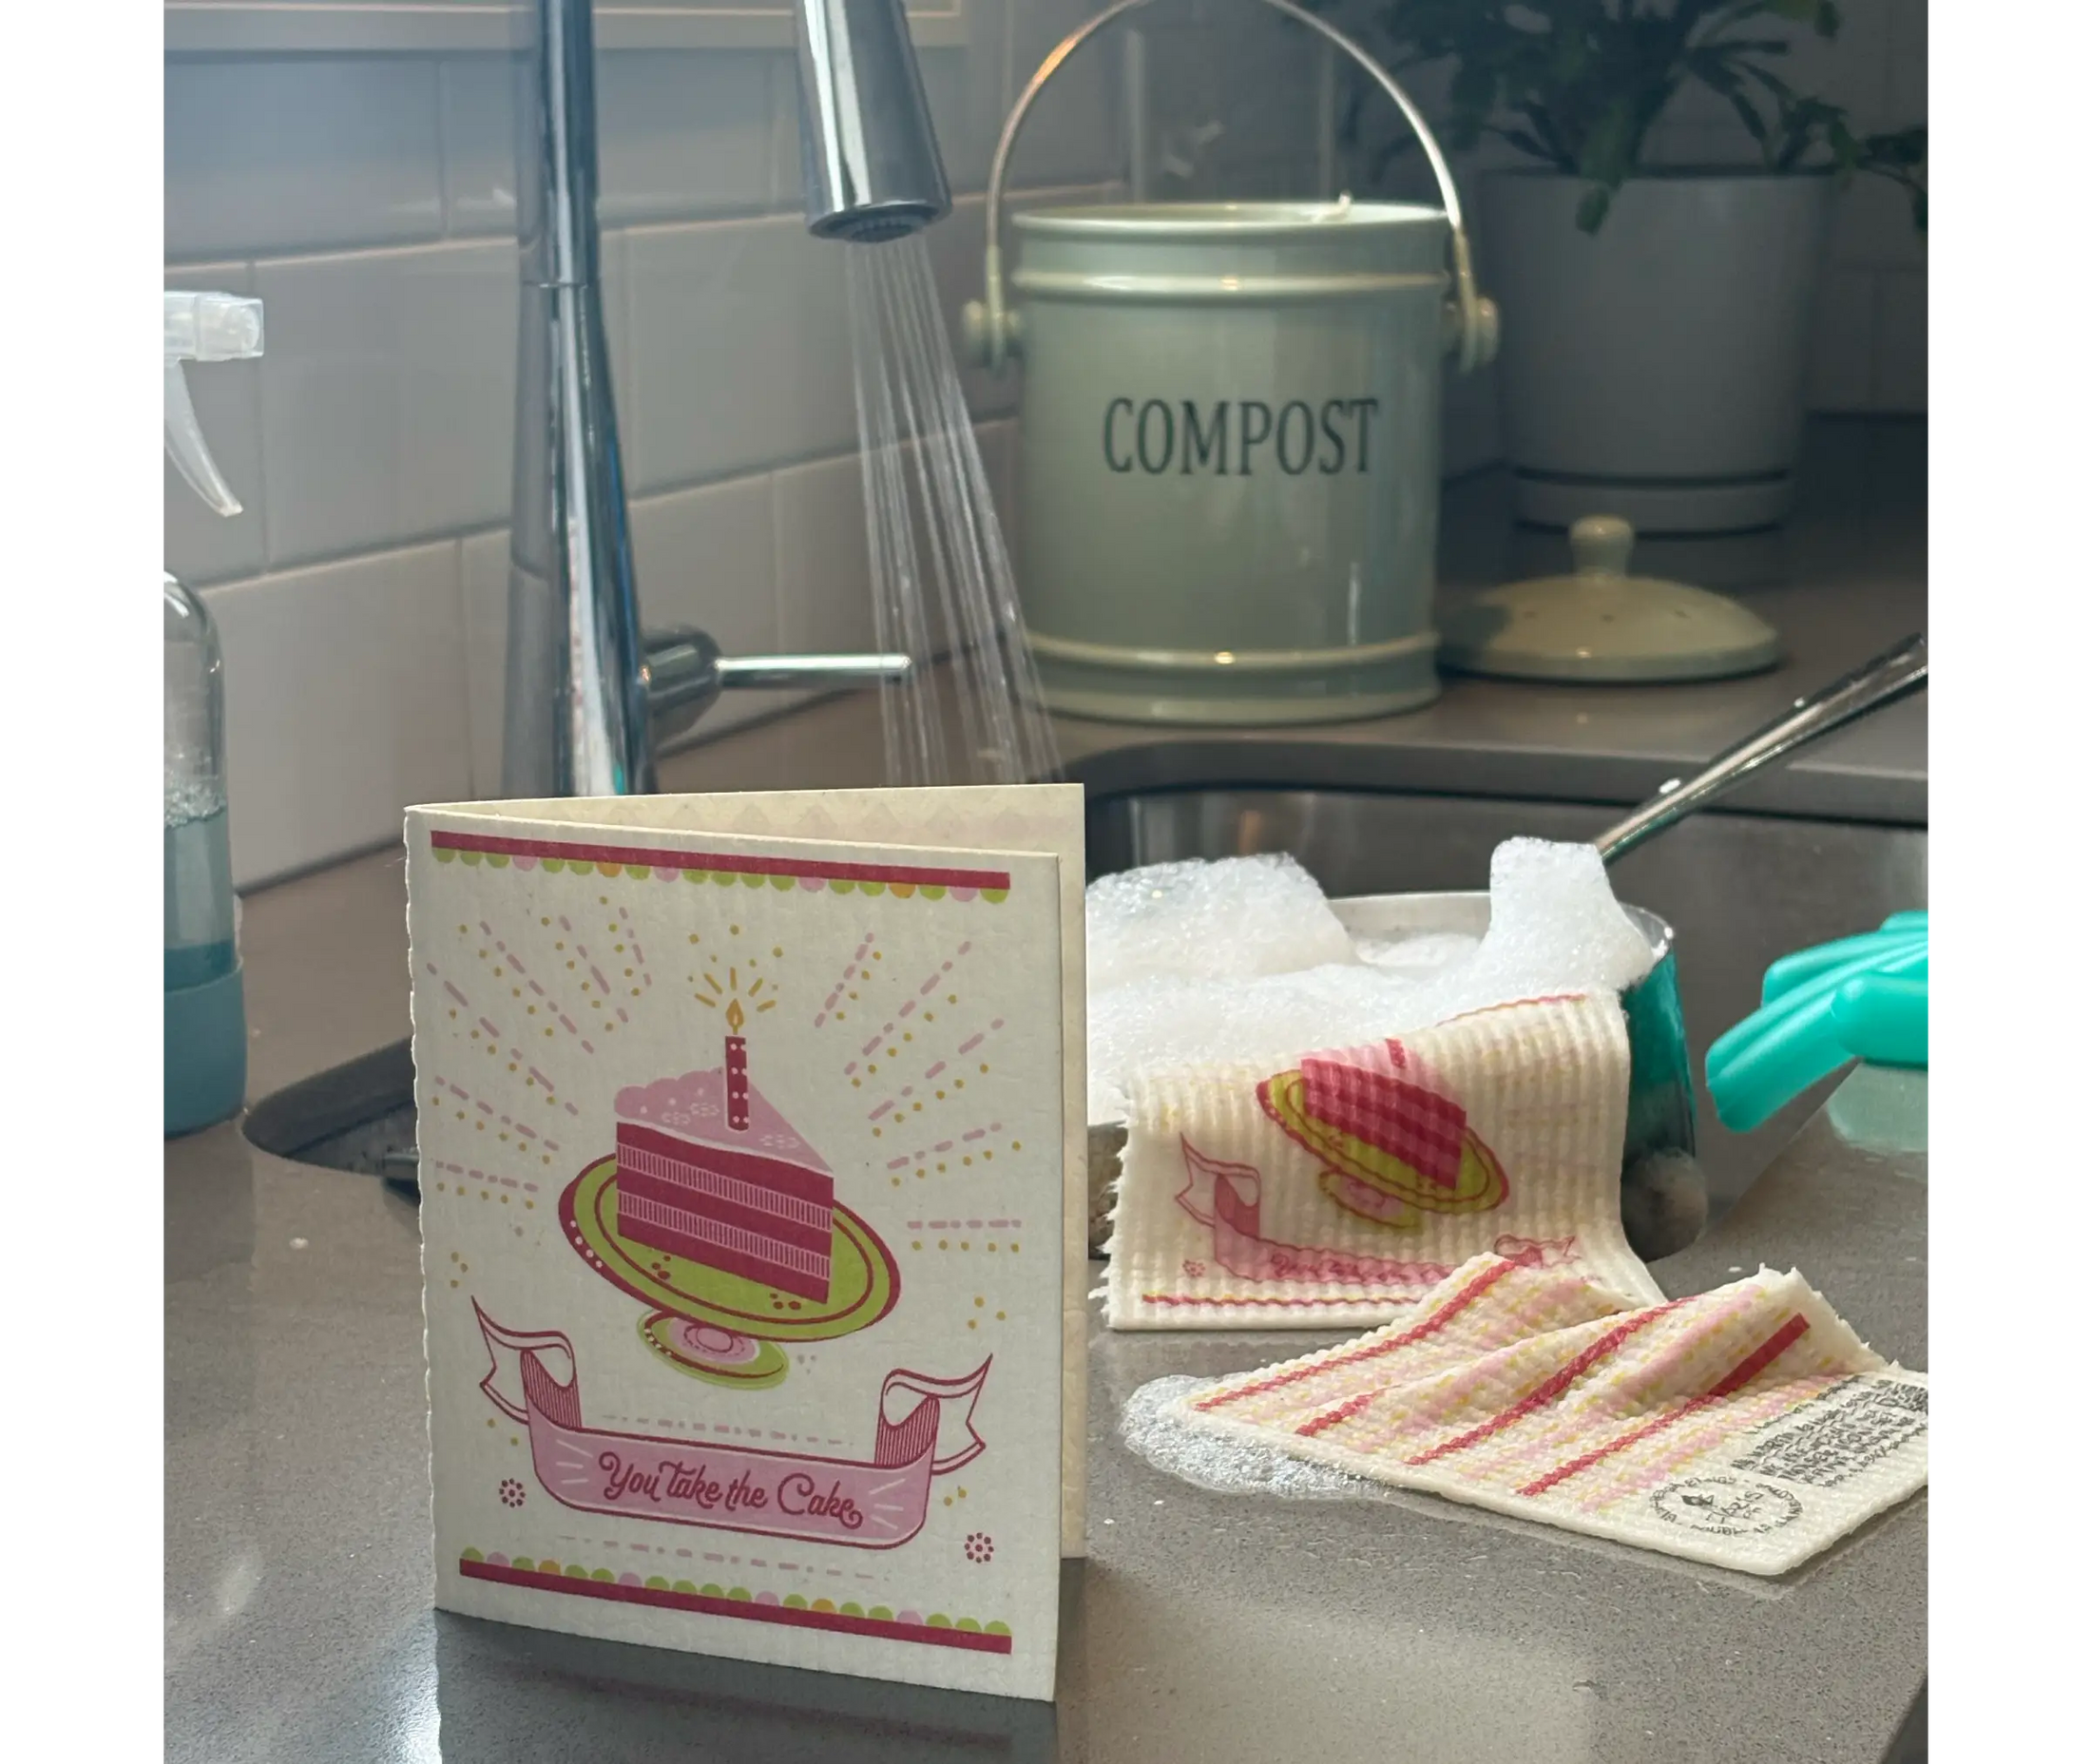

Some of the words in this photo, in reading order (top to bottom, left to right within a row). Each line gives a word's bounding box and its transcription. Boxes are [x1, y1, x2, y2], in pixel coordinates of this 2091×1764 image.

[1103, 396, 1379, 475] COMPOST
[598, 1450, 661, 1502] You
[724, 1469, 768, 1511] the
[777, 1472, 864, 1529] Cake
